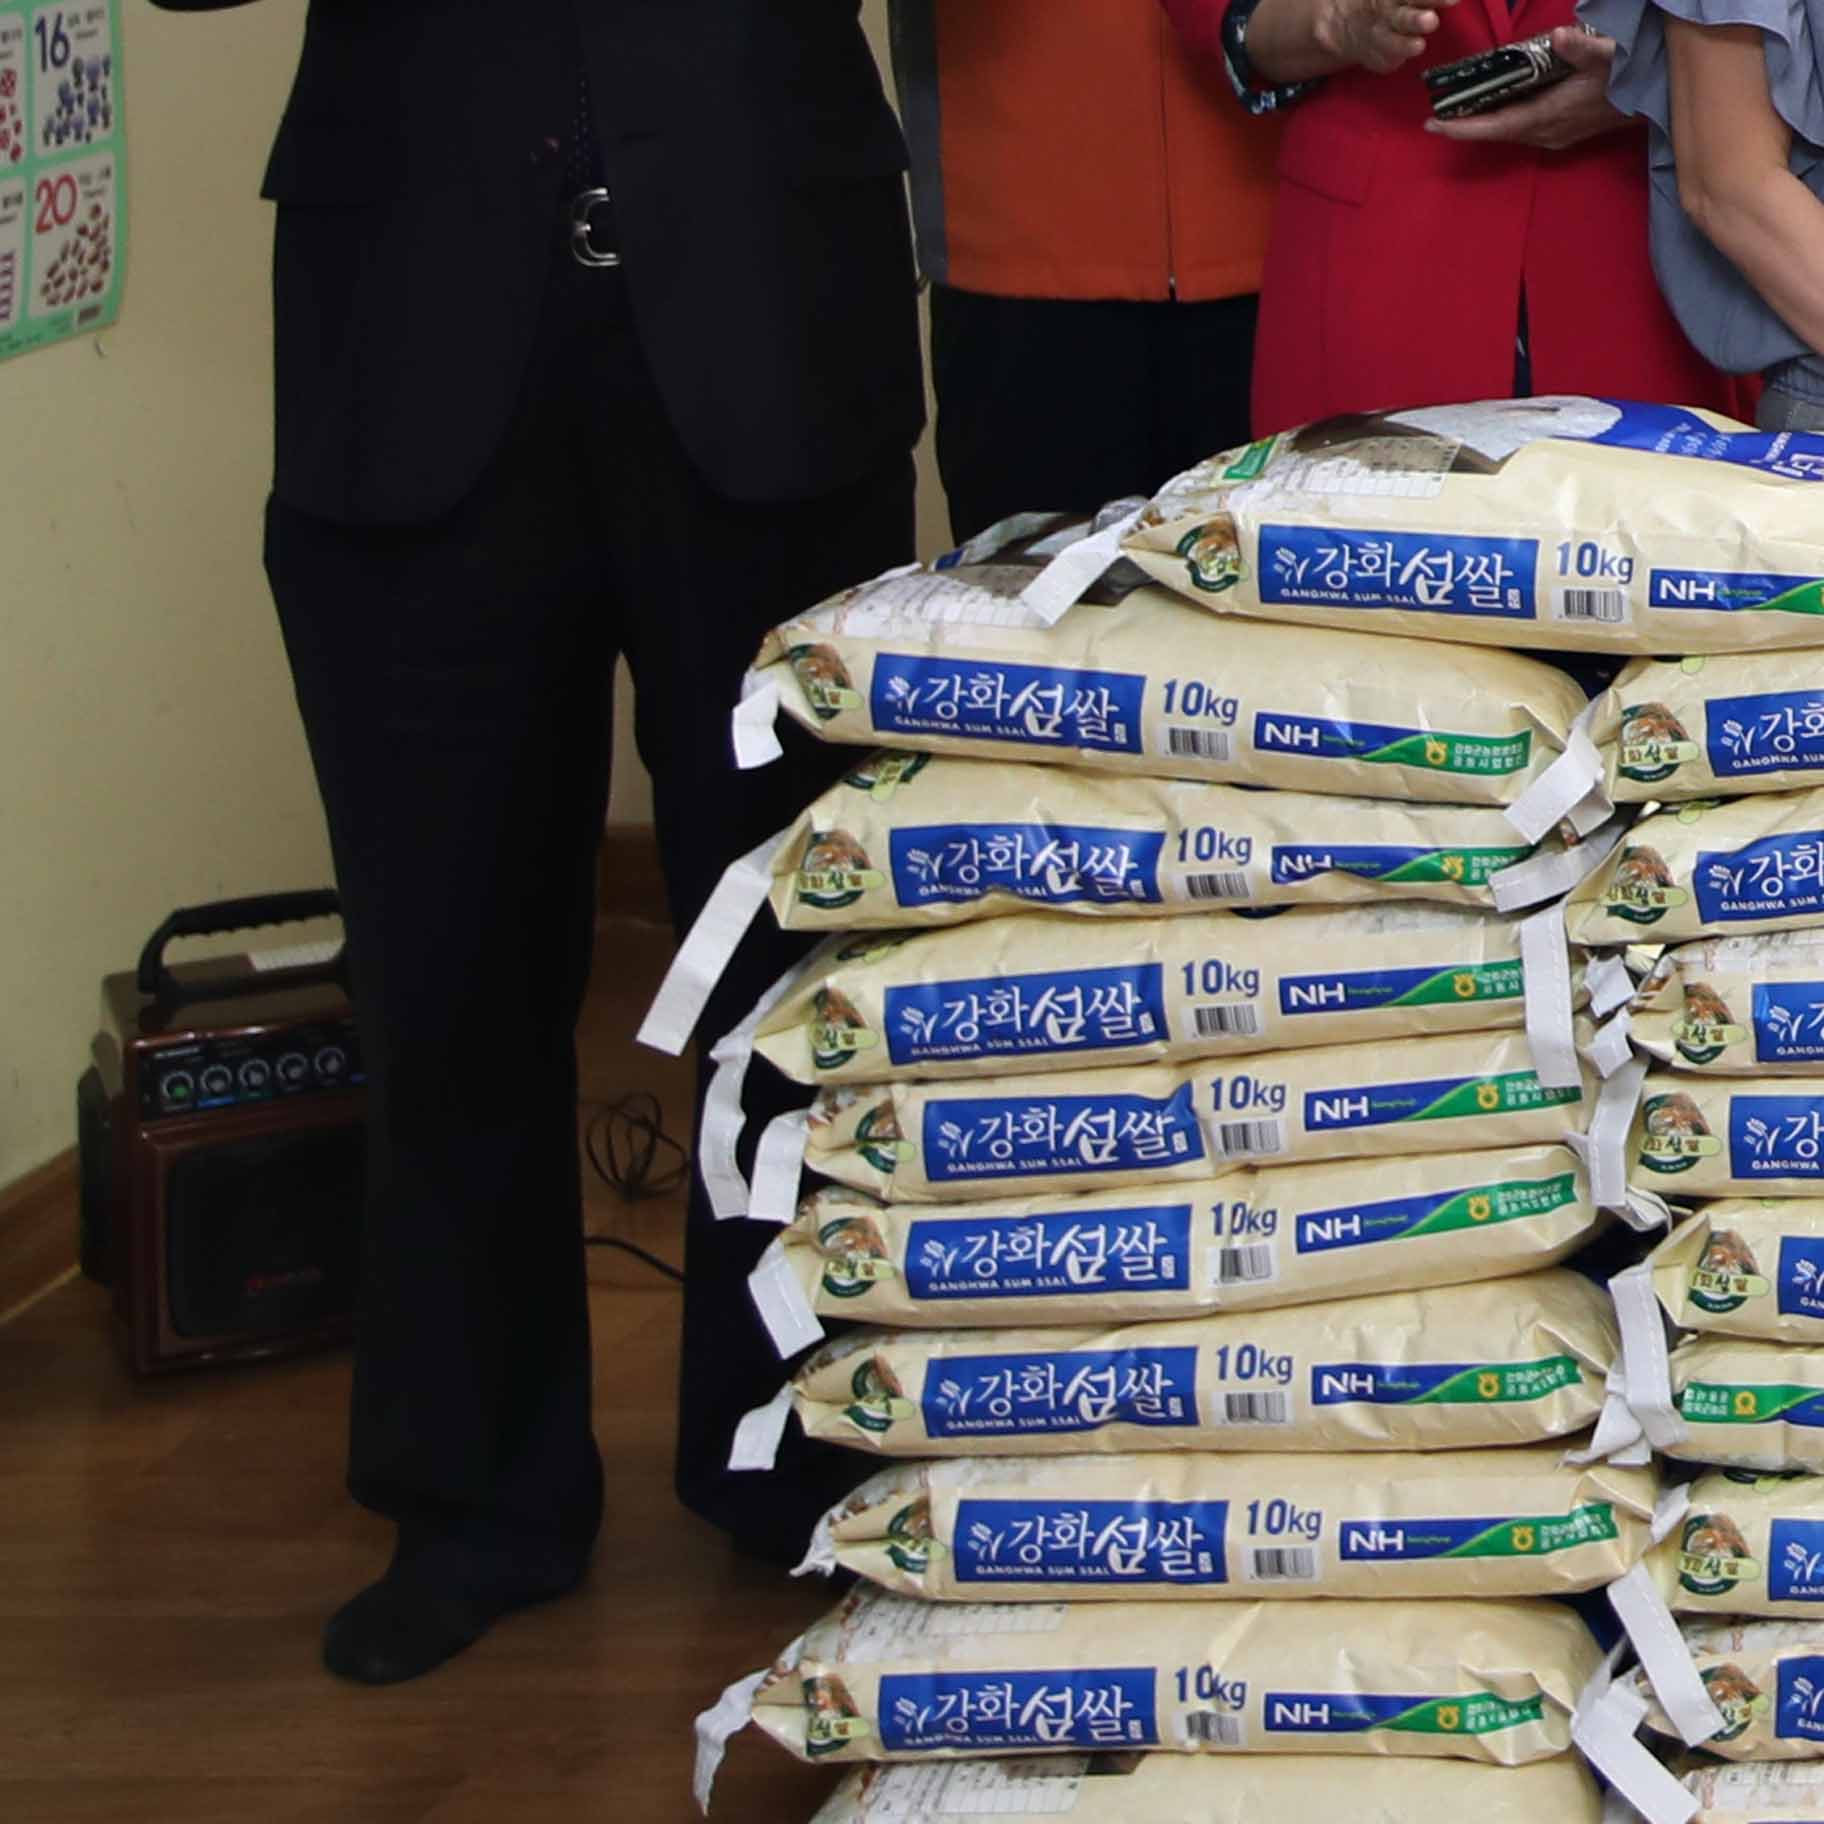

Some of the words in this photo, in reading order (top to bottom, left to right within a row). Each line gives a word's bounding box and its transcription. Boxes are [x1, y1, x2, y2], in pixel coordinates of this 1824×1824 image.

[35, 12, 70, 73] 16
[34, 174, 78, 235] 20
[1315, 542, 1520, 608] 강화섬쌀
[1559, 542, 1634, 584] 10kg
[1661, 579, 1715, 600] NH
[927, 673, 1126, 743] 강화섬쌀
[1164, 680, 1238, 726] 10kg
[1265, 723, 1318, 747] NH
[1177, 827, 1251, 866] 10kg
[1182, 960, 1259, 998] 10kg
[1290, 983, 1344, 1005] NH
[944, 982, 1141, 1043] 강화섬쌀
[1211, 1076, 1285, 1112] 10kg
[1315, 1096, 1368, 1121] NH
[979, 1105, 1175, 1164] 강화섬쌀
[1211, 1202, 1277, 1237] 10kg
[1306, 1215, 1360, 1243] NH
[963, 1222, 1174, 1284] 강화섬쌀
[979, 1349, 1173, 1422] 강화섬쌀
[1217, 1344, 1292, 1385] 10kg
[1322, 1373, 1373, 1395] NH
[1248, 1499, 1321, 1541] 10kg
[1351, 1530, 1403, 1551] NH
[1010, 1511, 1212, 1575] 강화섬쌀
[1176, 1665, 1246, 1711] 10kg
[936, 1683, 1133, 1742] 강화섬쌀
[1275, 1703, 1328, 1724] NH
